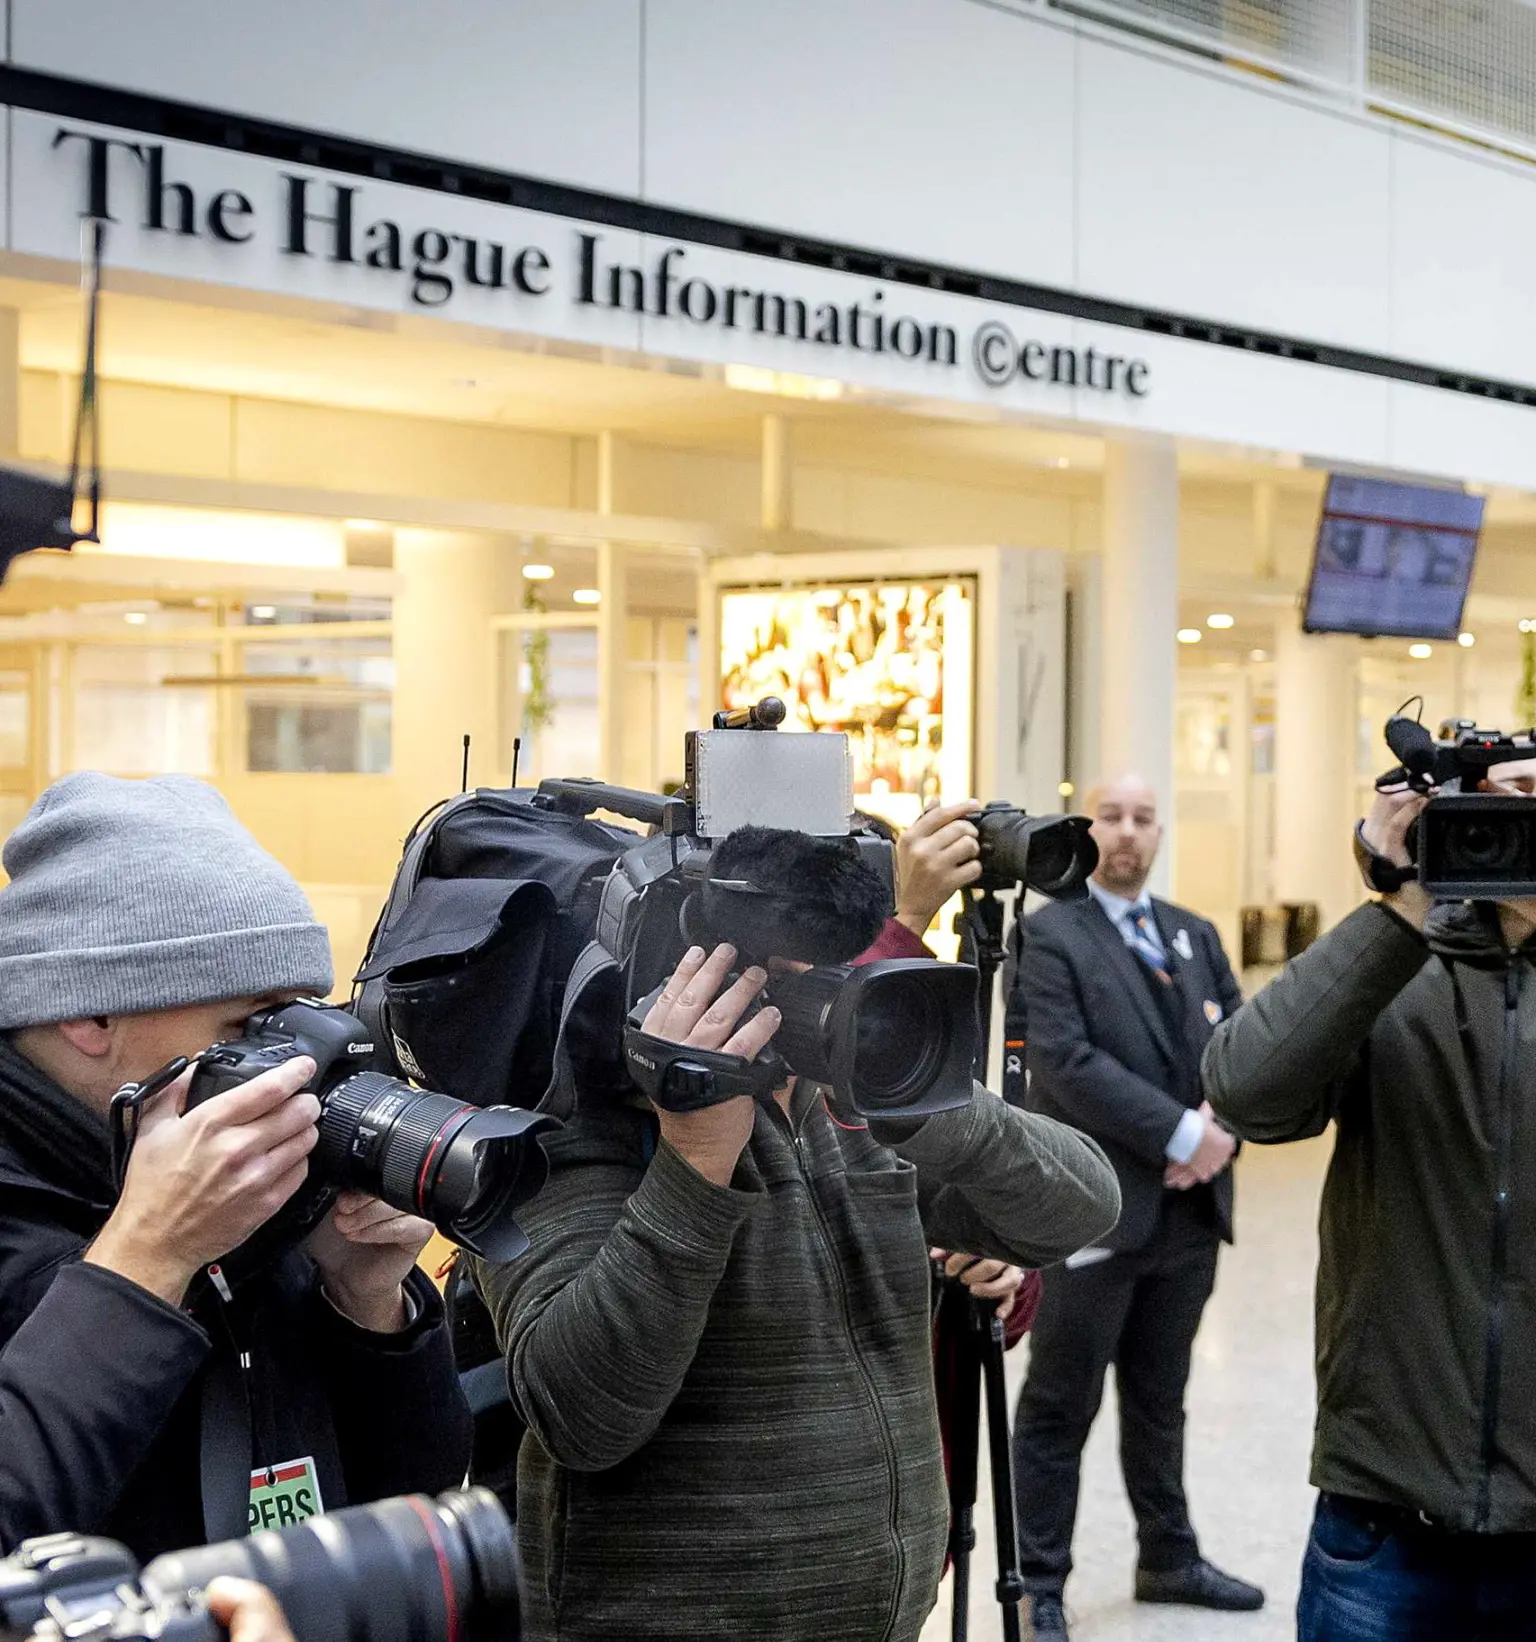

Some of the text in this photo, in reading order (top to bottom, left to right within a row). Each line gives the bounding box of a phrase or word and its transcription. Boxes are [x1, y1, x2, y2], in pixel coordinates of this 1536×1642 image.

[52, 127, 255, 243] The
[280, 172, 551, 305] Hague
[573, 232, 958, 365] Information
[347, 1042, 374, 1054] Canon
[627, 1047, 656, 1070] Canon
